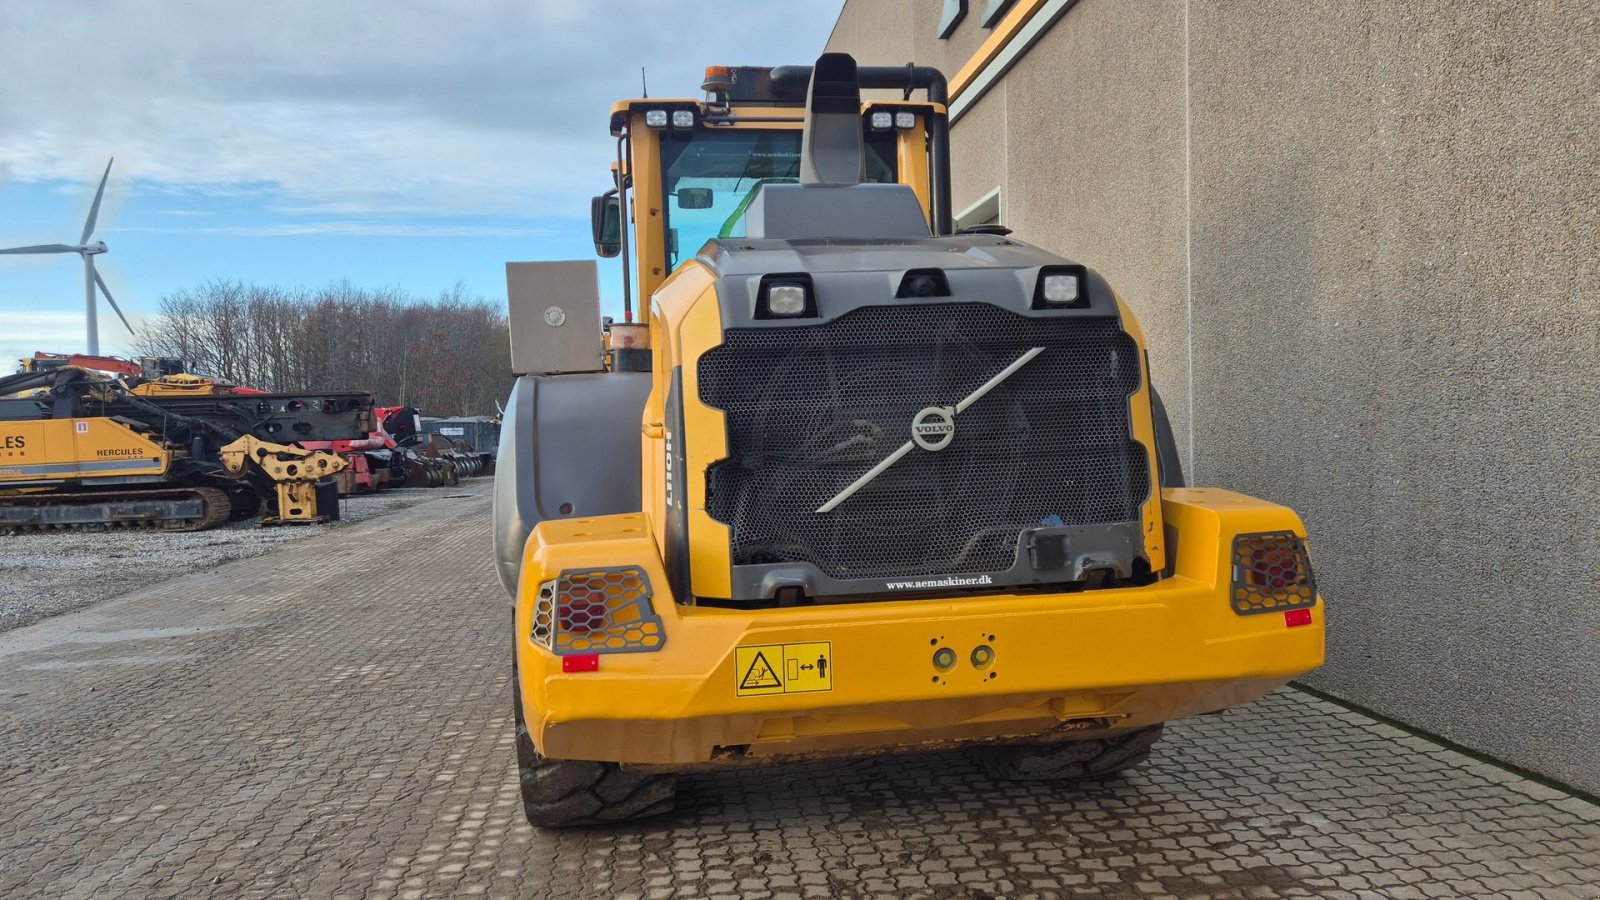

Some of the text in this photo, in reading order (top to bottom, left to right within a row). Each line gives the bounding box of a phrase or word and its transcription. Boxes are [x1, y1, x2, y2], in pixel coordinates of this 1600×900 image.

[915, 425, 953, 433] VOLVO
[96, 448, 143, 457] HERCULES
[665, 431, 673, 507] L110H
[886, 575, 993, 590] www.aemaskiner.dk
